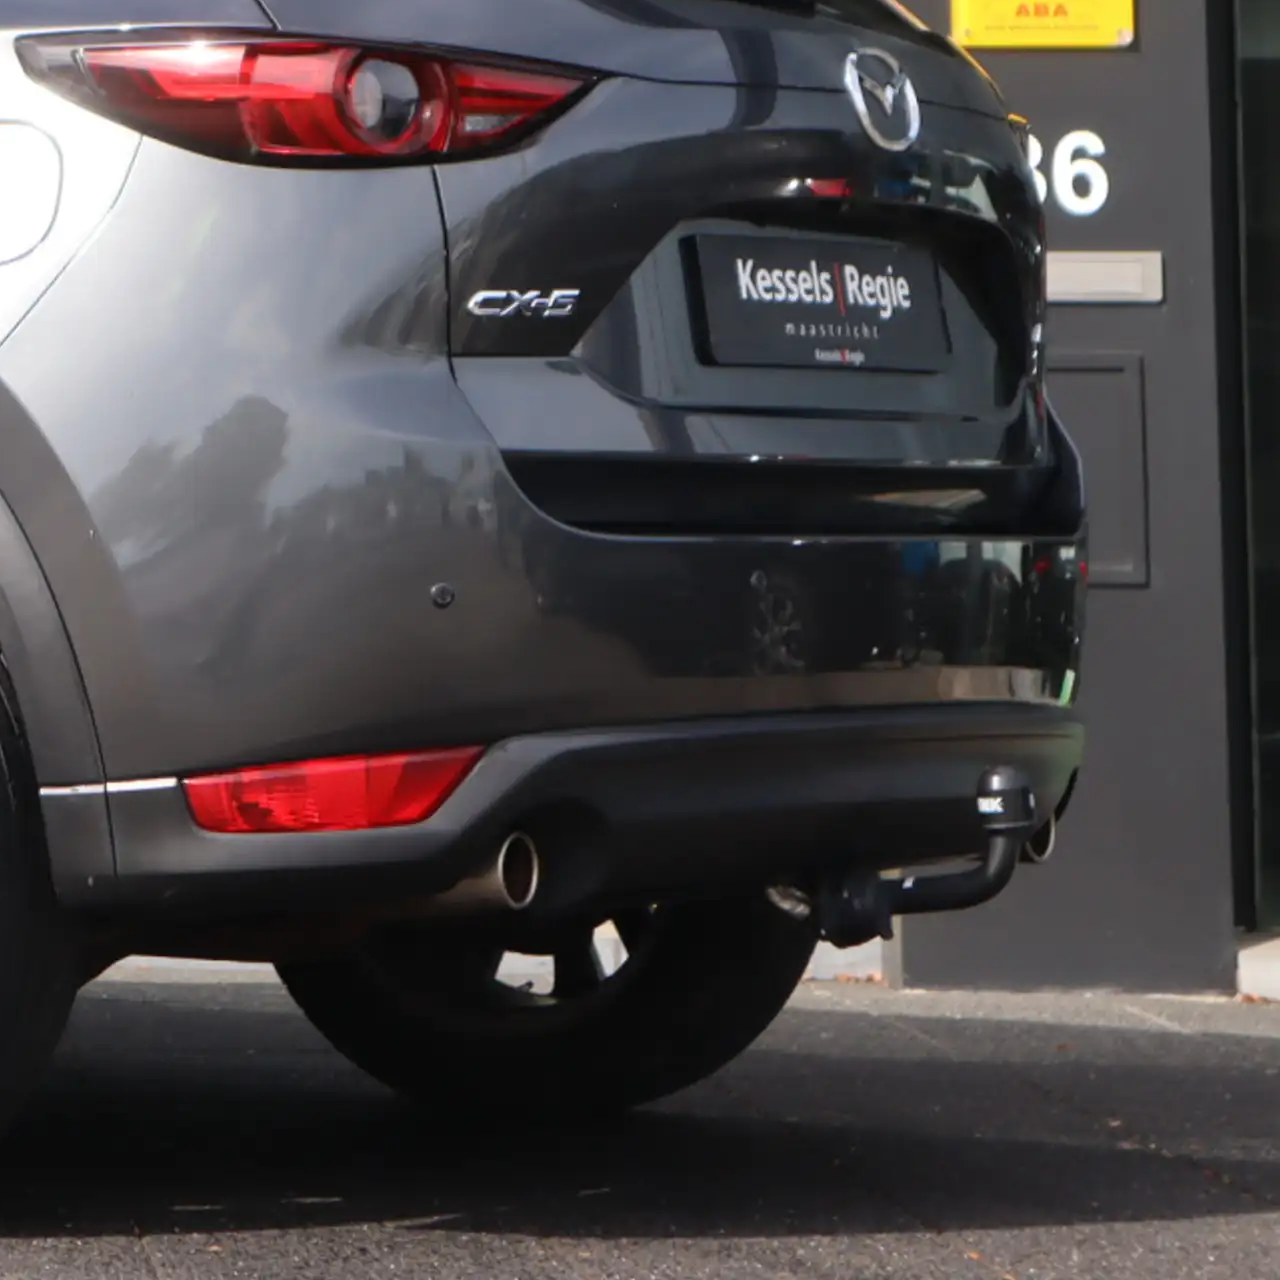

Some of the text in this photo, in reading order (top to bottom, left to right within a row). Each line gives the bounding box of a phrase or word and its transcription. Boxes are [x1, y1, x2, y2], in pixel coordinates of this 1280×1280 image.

[1015, 3, 1068, 18] ABA
[466, 288, 581, 317] CX-5
[736, 258, 911, 319] Kessels Regie
